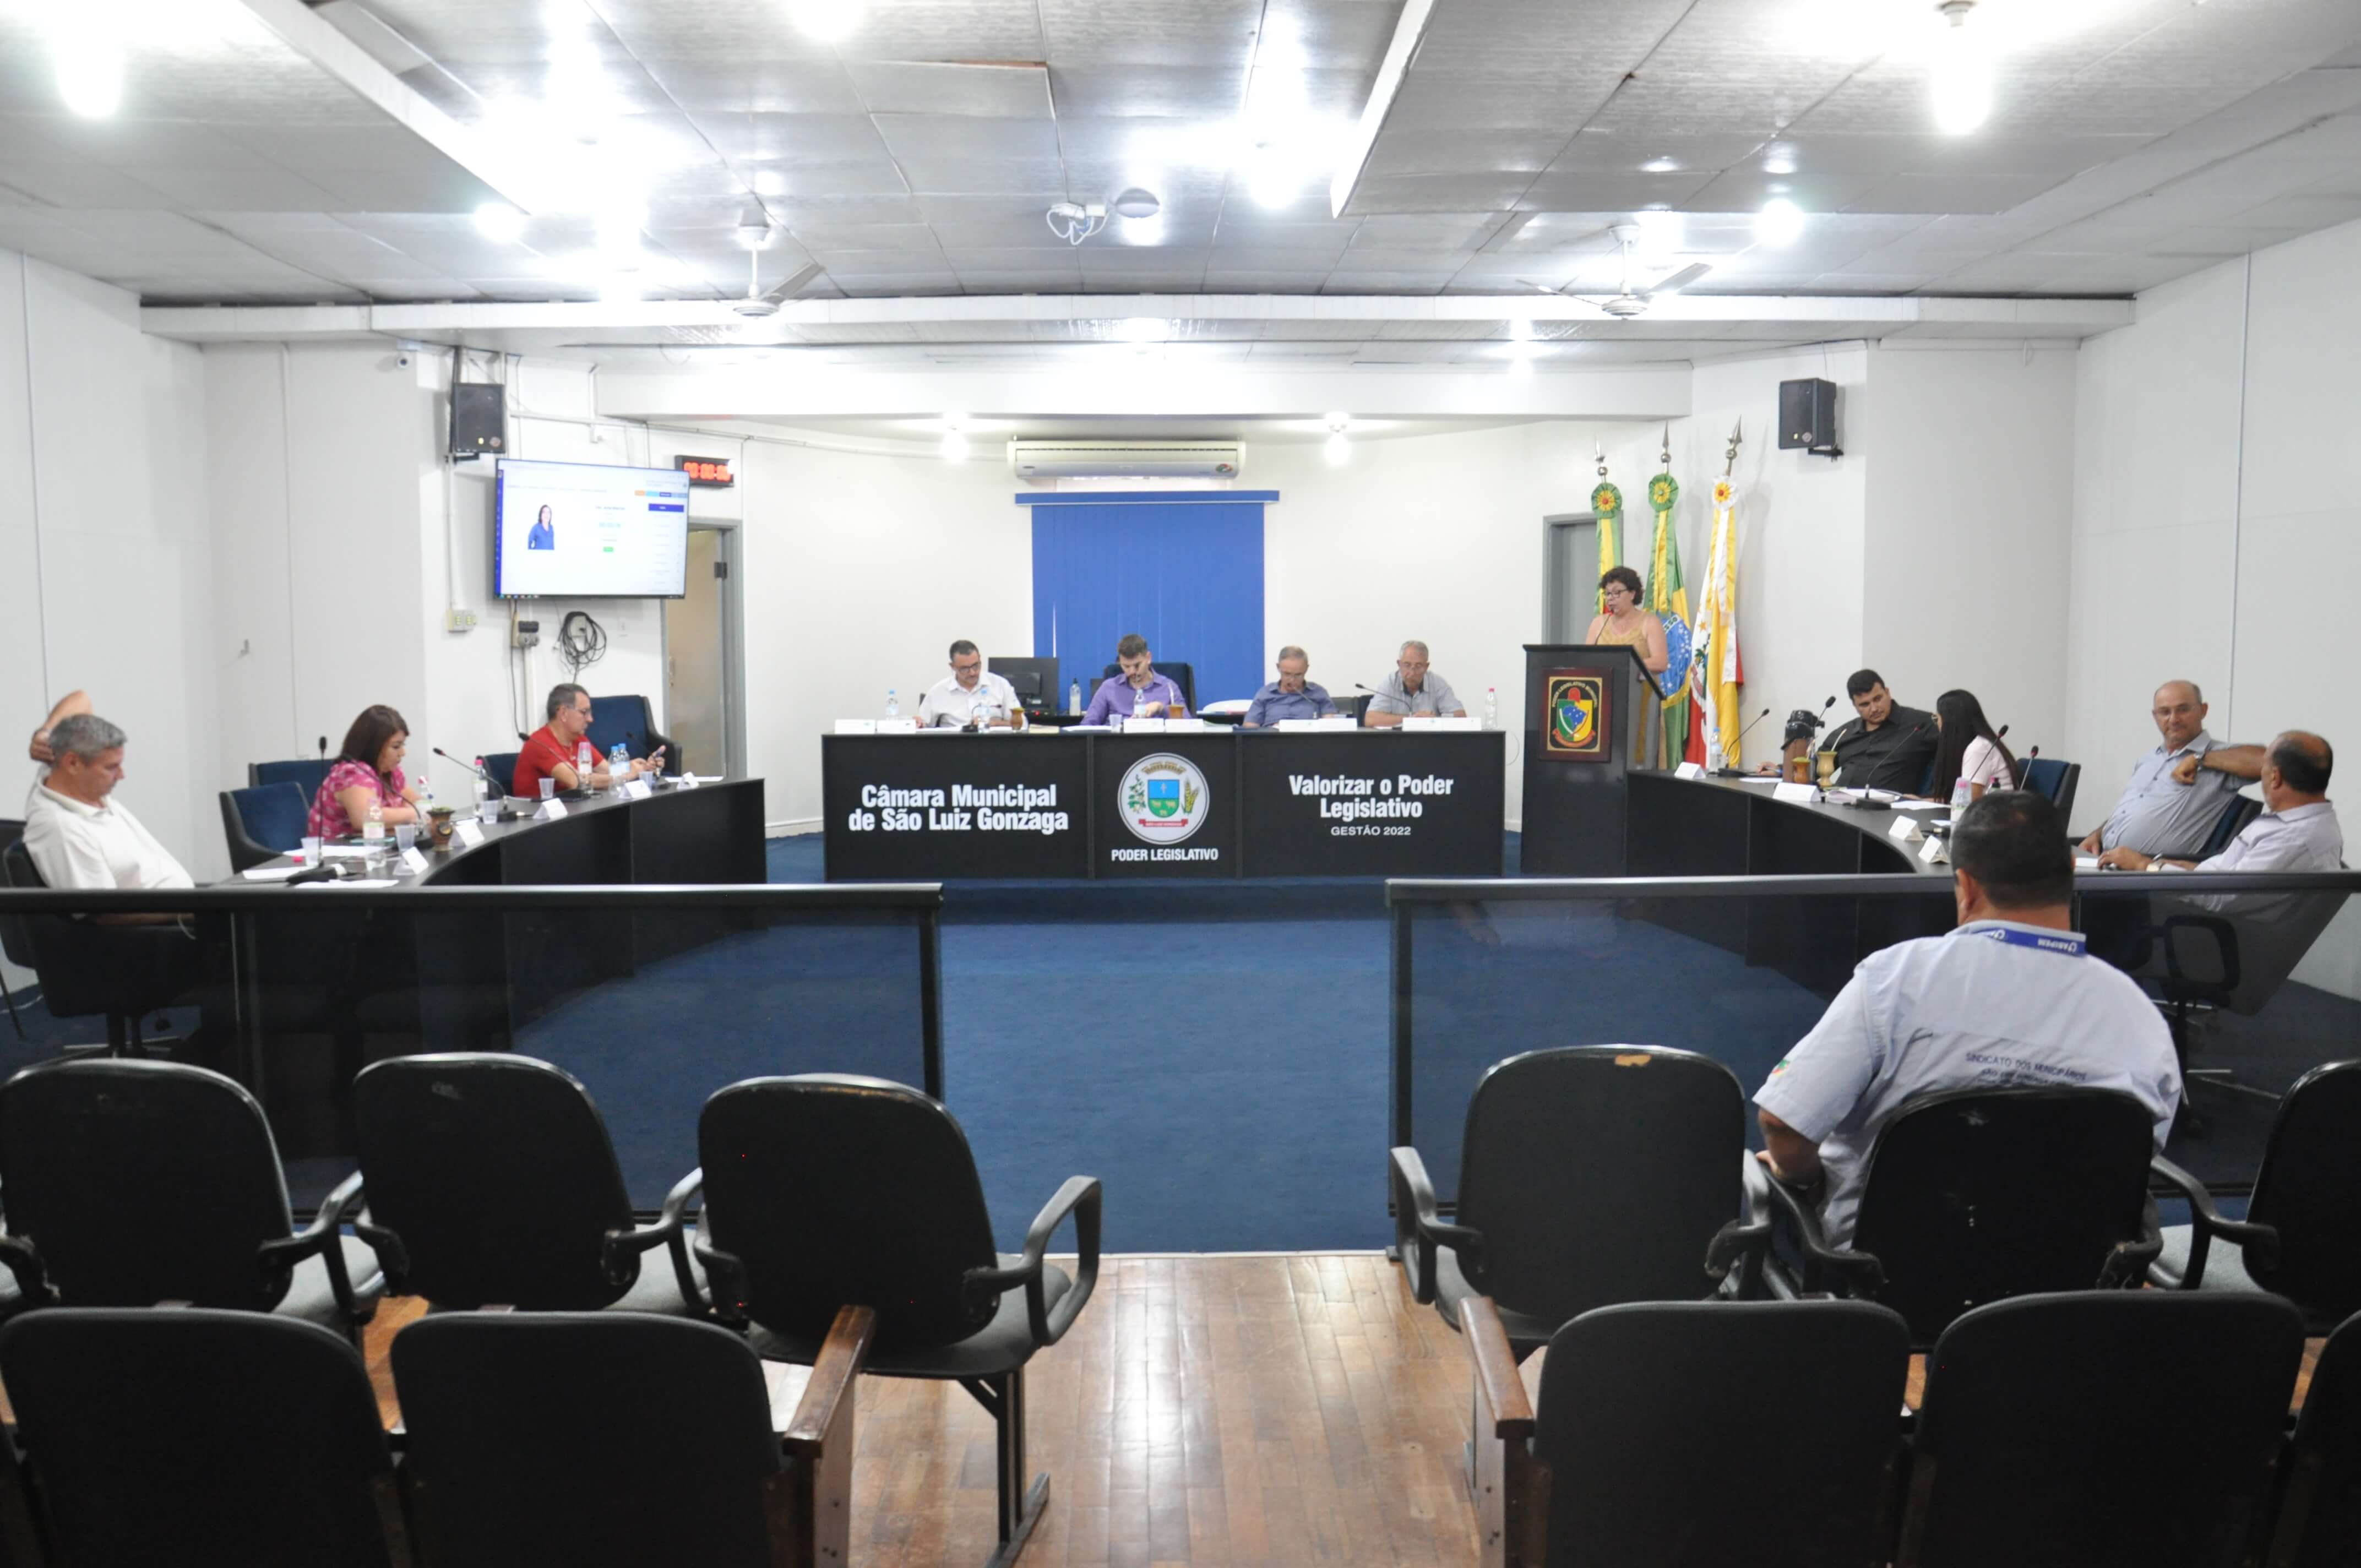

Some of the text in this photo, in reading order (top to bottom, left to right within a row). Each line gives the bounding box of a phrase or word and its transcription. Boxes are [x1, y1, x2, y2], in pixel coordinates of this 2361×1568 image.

[1289, 774, 1454, 796] Valorizar o Poder
[862, 784, 1057, 810] Câmara Municipal
[848, 807, 1068, 835] de São Luiz Gonzaga
[1320, 797, 1423, 823] Legislativo
[1330, 824, 1411, 836] GESTÃO 2022
[1111, 848, 1218, 861] PODER LEGISLATIVO
[1965, 1052, 2011, 1067] SINDICATO
[2015, 1059, 2031, 1070] DOS
